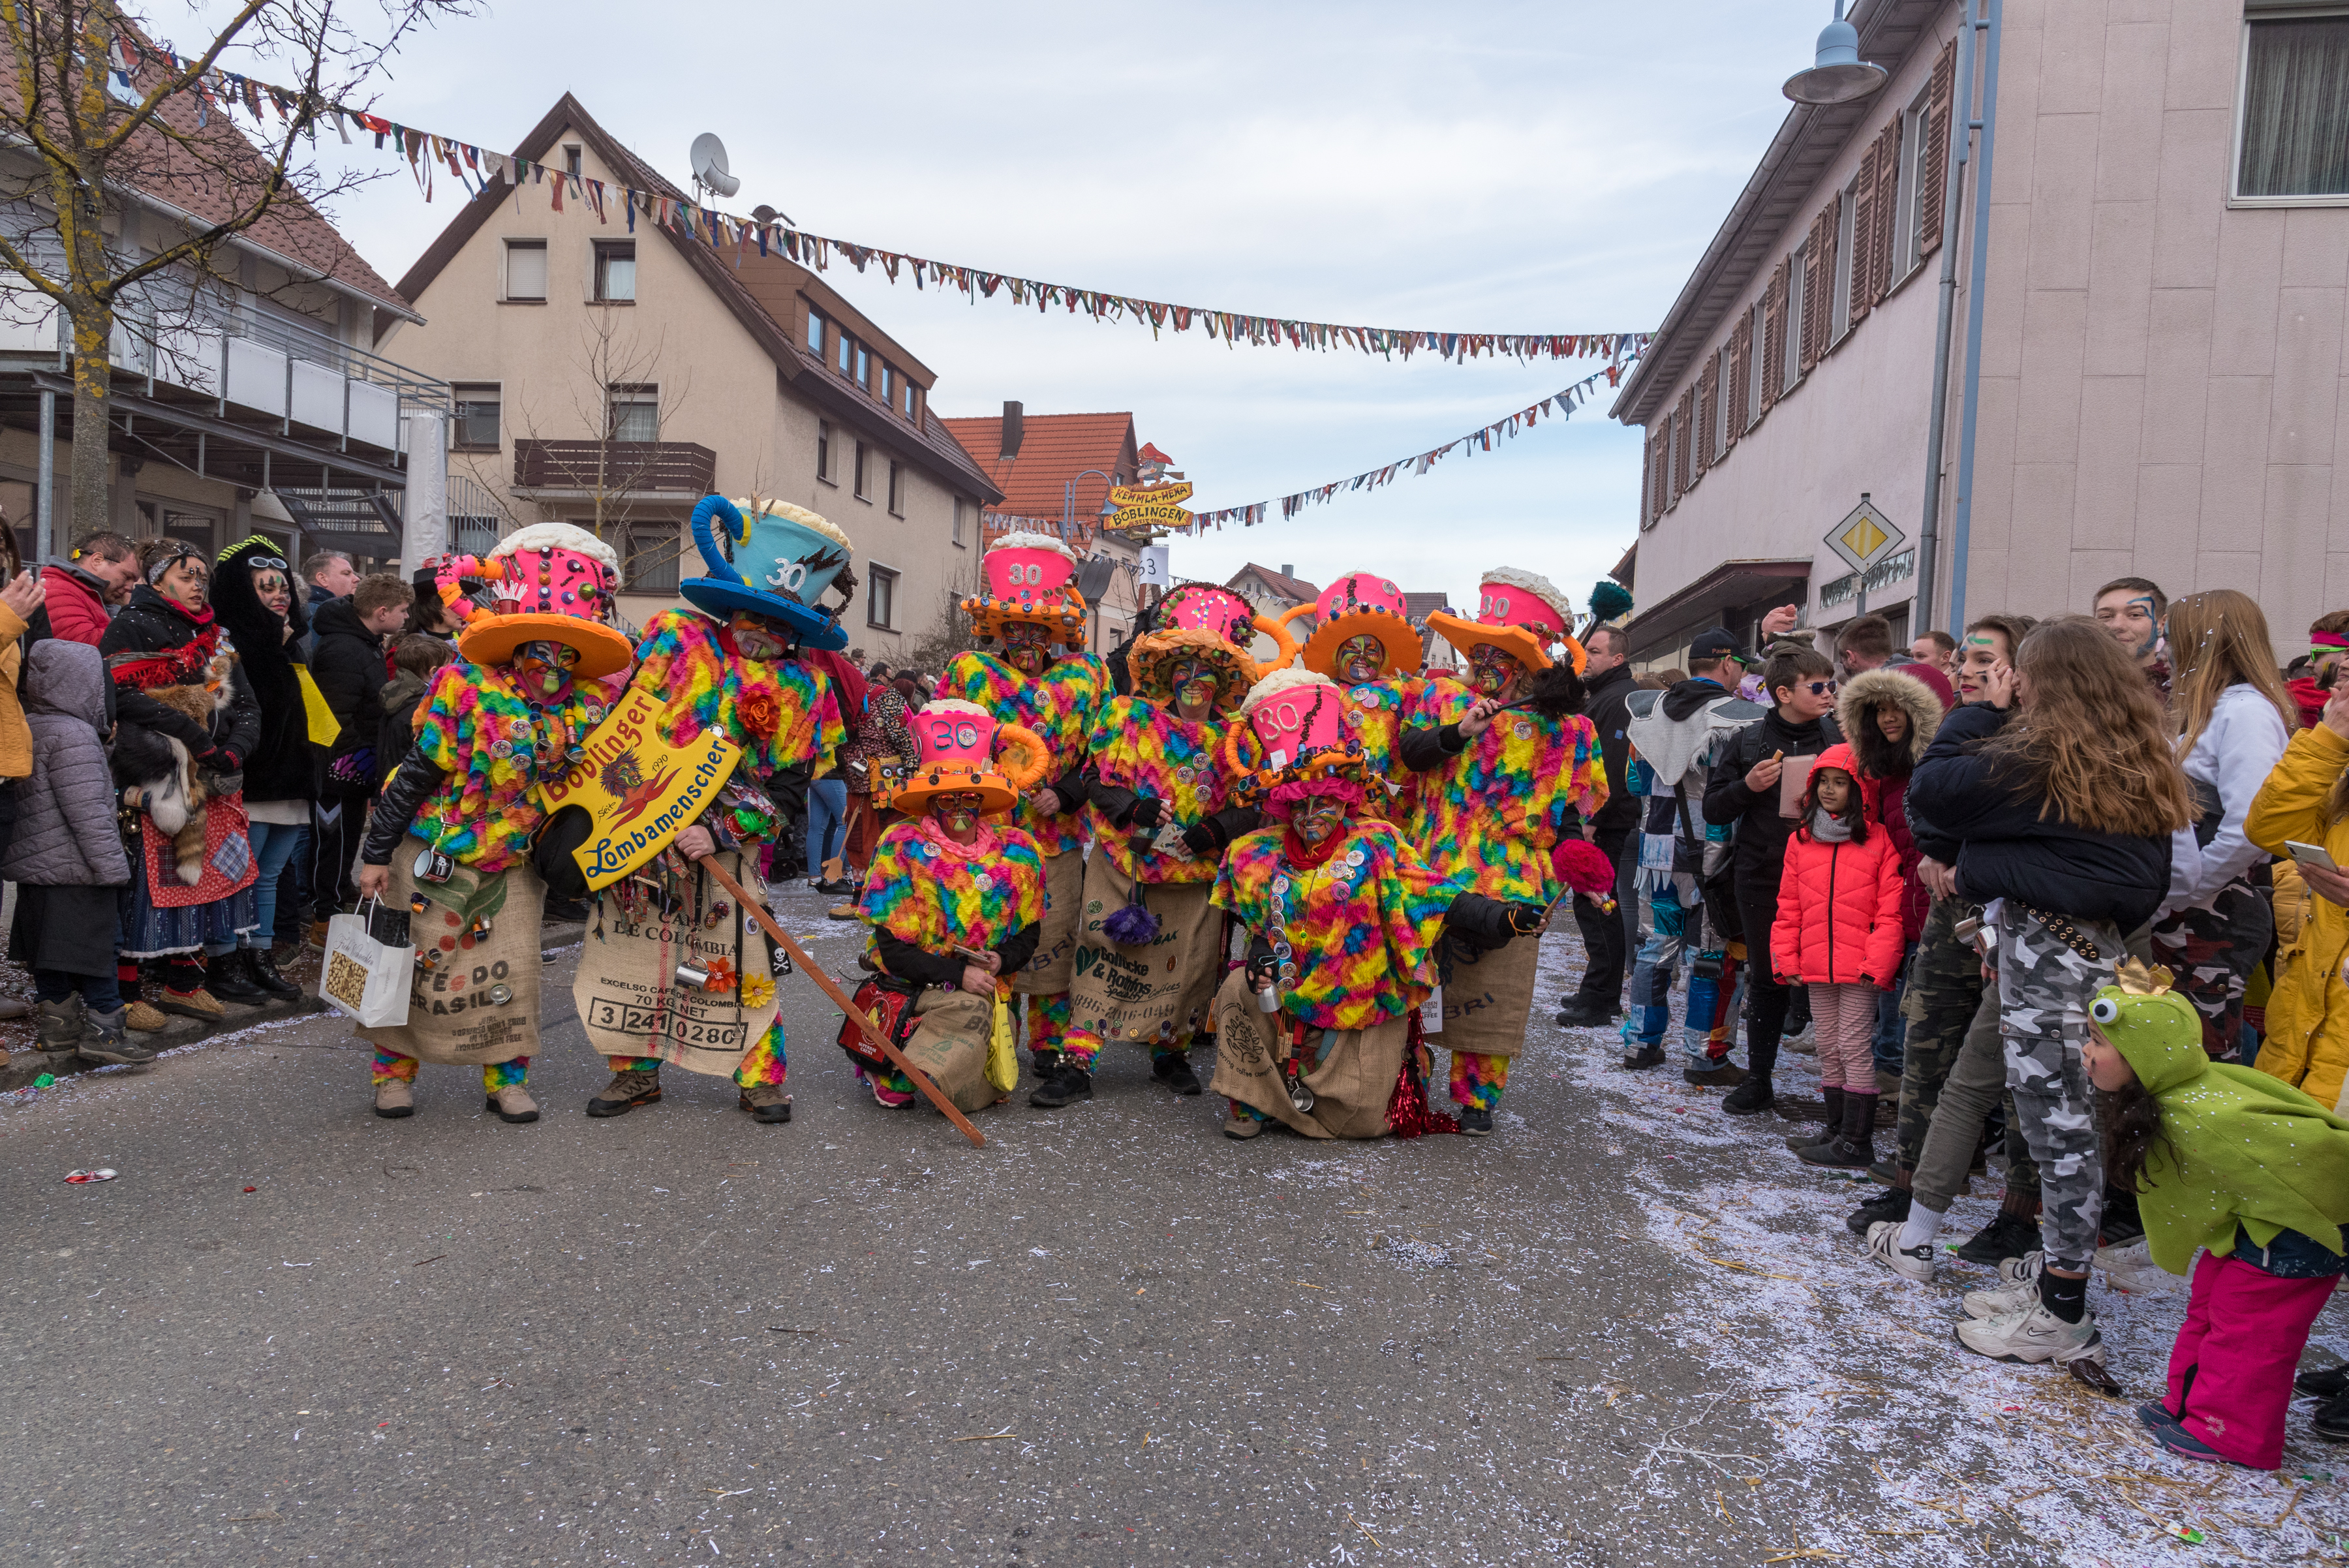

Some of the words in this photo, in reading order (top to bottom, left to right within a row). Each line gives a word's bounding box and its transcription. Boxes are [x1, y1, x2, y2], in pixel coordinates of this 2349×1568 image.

[1114, 485, 1187, 504] KEMMLA-HEXA
[1113, 507, 1186, 527] BÖBLINGEN
[766, 558, 806, 592] 30
[1008, 563, 1042, 587] 30
[1481, 595, 1510, 619] 30
[1258, 703, 1299, 741] 30
[931, 720, 977, 751] 30
[598, 801, 616, 823] Seit
[652, 754, 668, 772] 1990
[583, 740, 727, 878] Lombamenscher
[645, 927, 736, 956] COLOMBIA
[472, 960, 509, 985] DO
[1092, 963, 1106, 979] &
[601, 977, 647, 992] EXCELSO
[677, 992, 688, 1001] DE
[690, 996, 745, 1008] COLOMBIA
[1148, 982, 1181, 998] Coffees
[635, 994, 652, 1006] 70
[680, 1004, 709, 1018] NET
[600, 1006, 615, 1024] 3
[626, 1011, 668, 1029] 241
[676, 1021, 735, 1045] 0280
[506, 1034, 522, 1043] FREE
[858, 1041, 877, 1053] SUPERBAR
[860, 1047, 873, 1056] CREMA
[1218, 1049, 1235, 1069] caring
[1236, 1068, 1252, 1077] coffee
